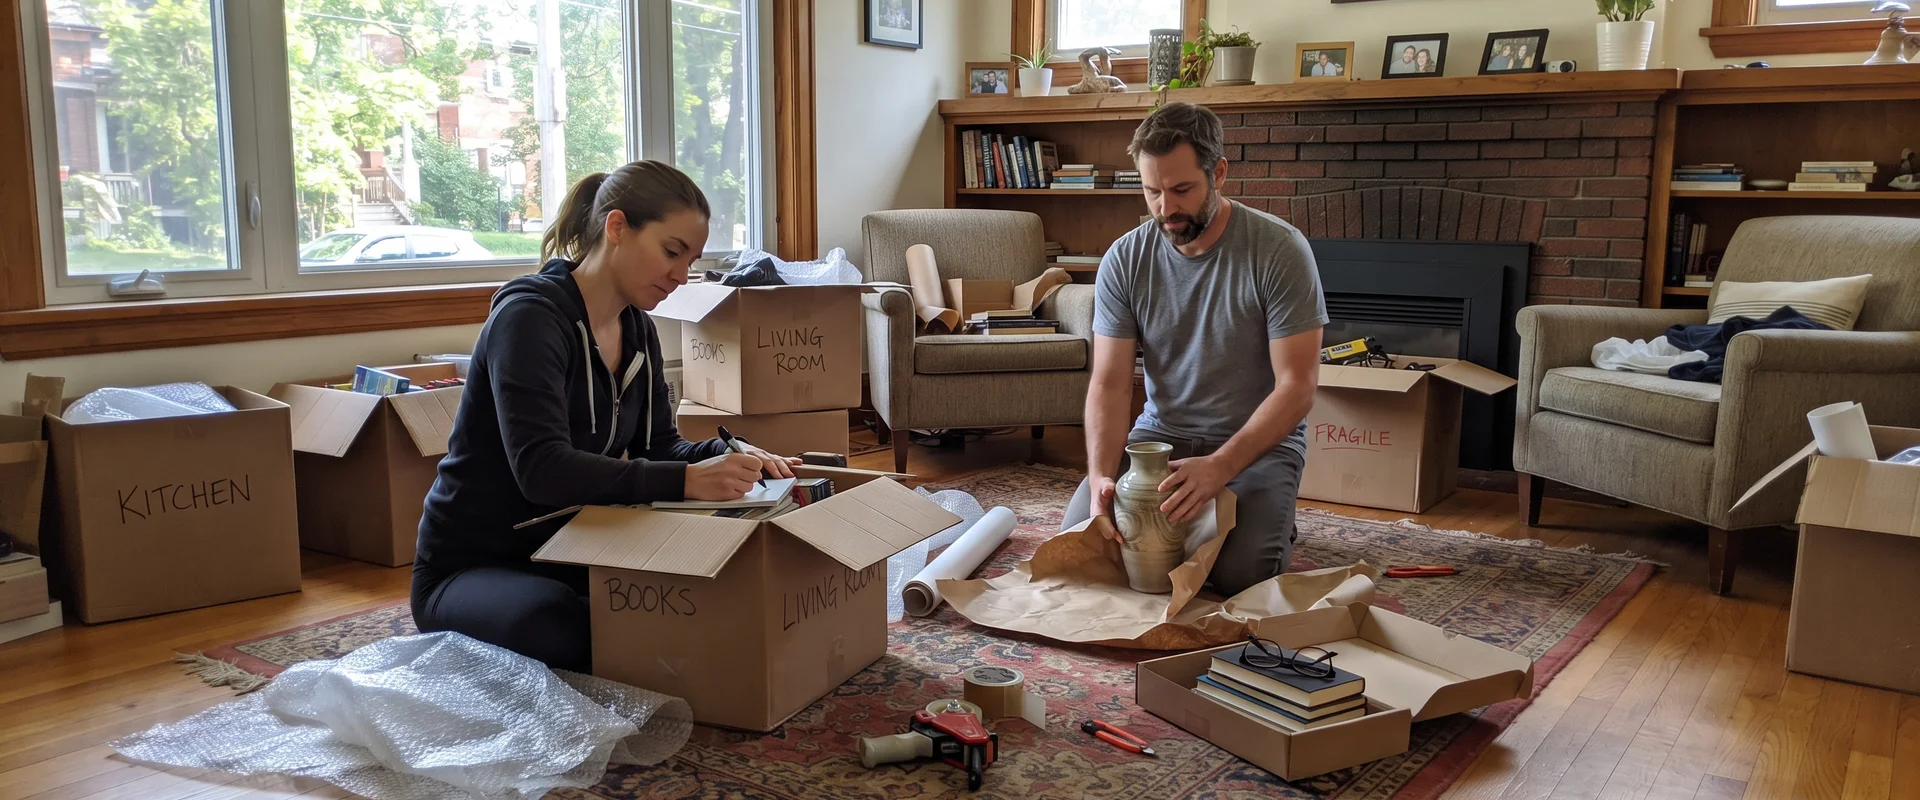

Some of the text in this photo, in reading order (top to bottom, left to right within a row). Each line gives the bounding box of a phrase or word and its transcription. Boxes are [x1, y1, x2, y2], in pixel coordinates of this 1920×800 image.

[757, 326, 824, 349] LIVING
[690, 338, 725, 364] BOOKS
[773, 352, 826, 375] ROOM
[1315, 422, 1392, 446] FRAGILE
[117, 474, 251, 524] KITCHEN
[603, 577, 697, 616] BOOKS
[783, 574, 838, 632] LIVING
